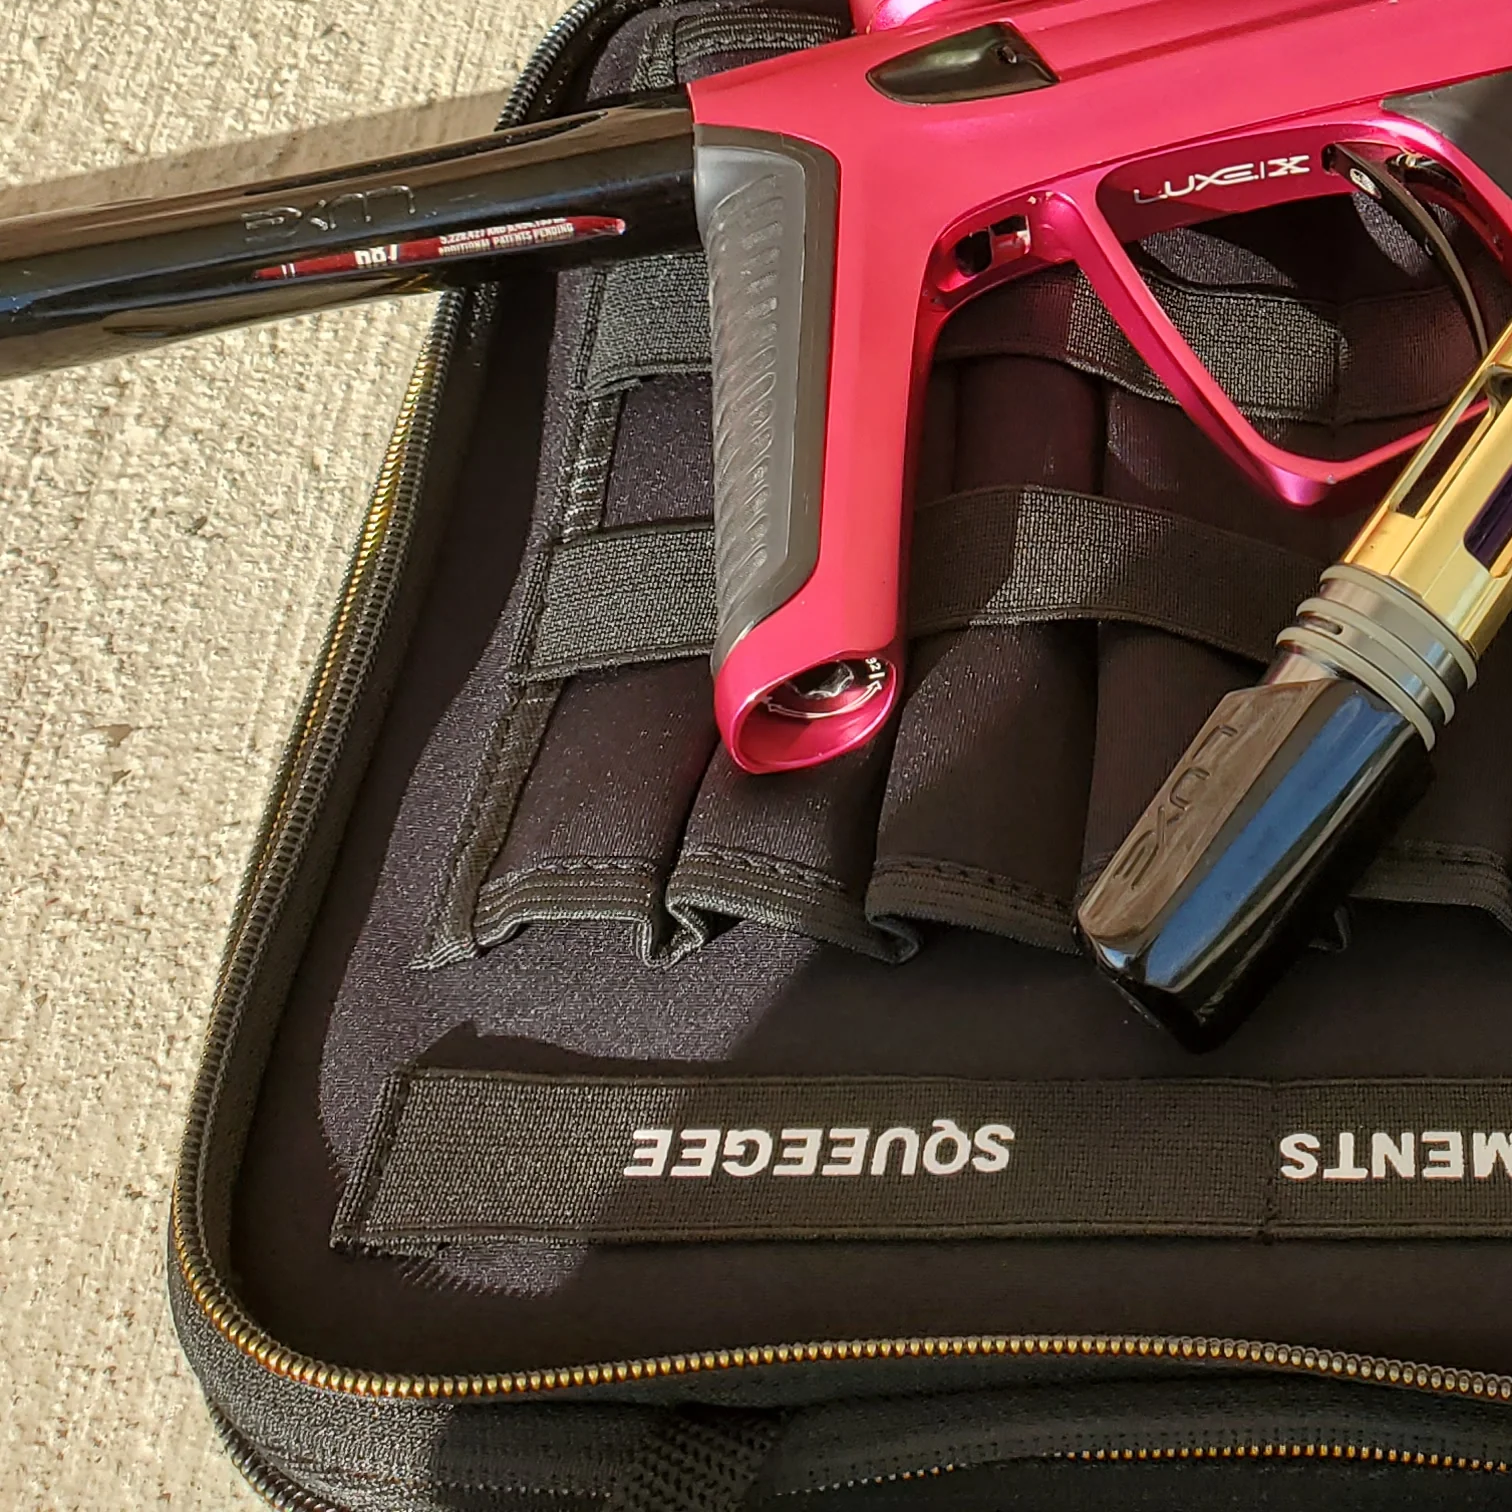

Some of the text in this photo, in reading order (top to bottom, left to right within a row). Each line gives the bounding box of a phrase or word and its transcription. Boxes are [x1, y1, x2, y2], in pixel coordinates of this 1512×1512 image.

[532, 222, 574, 244] PENDING
[1113, 724, 1239, 891] LUXE
[623, 1119, 1015, 1177] SQUEEGEE
